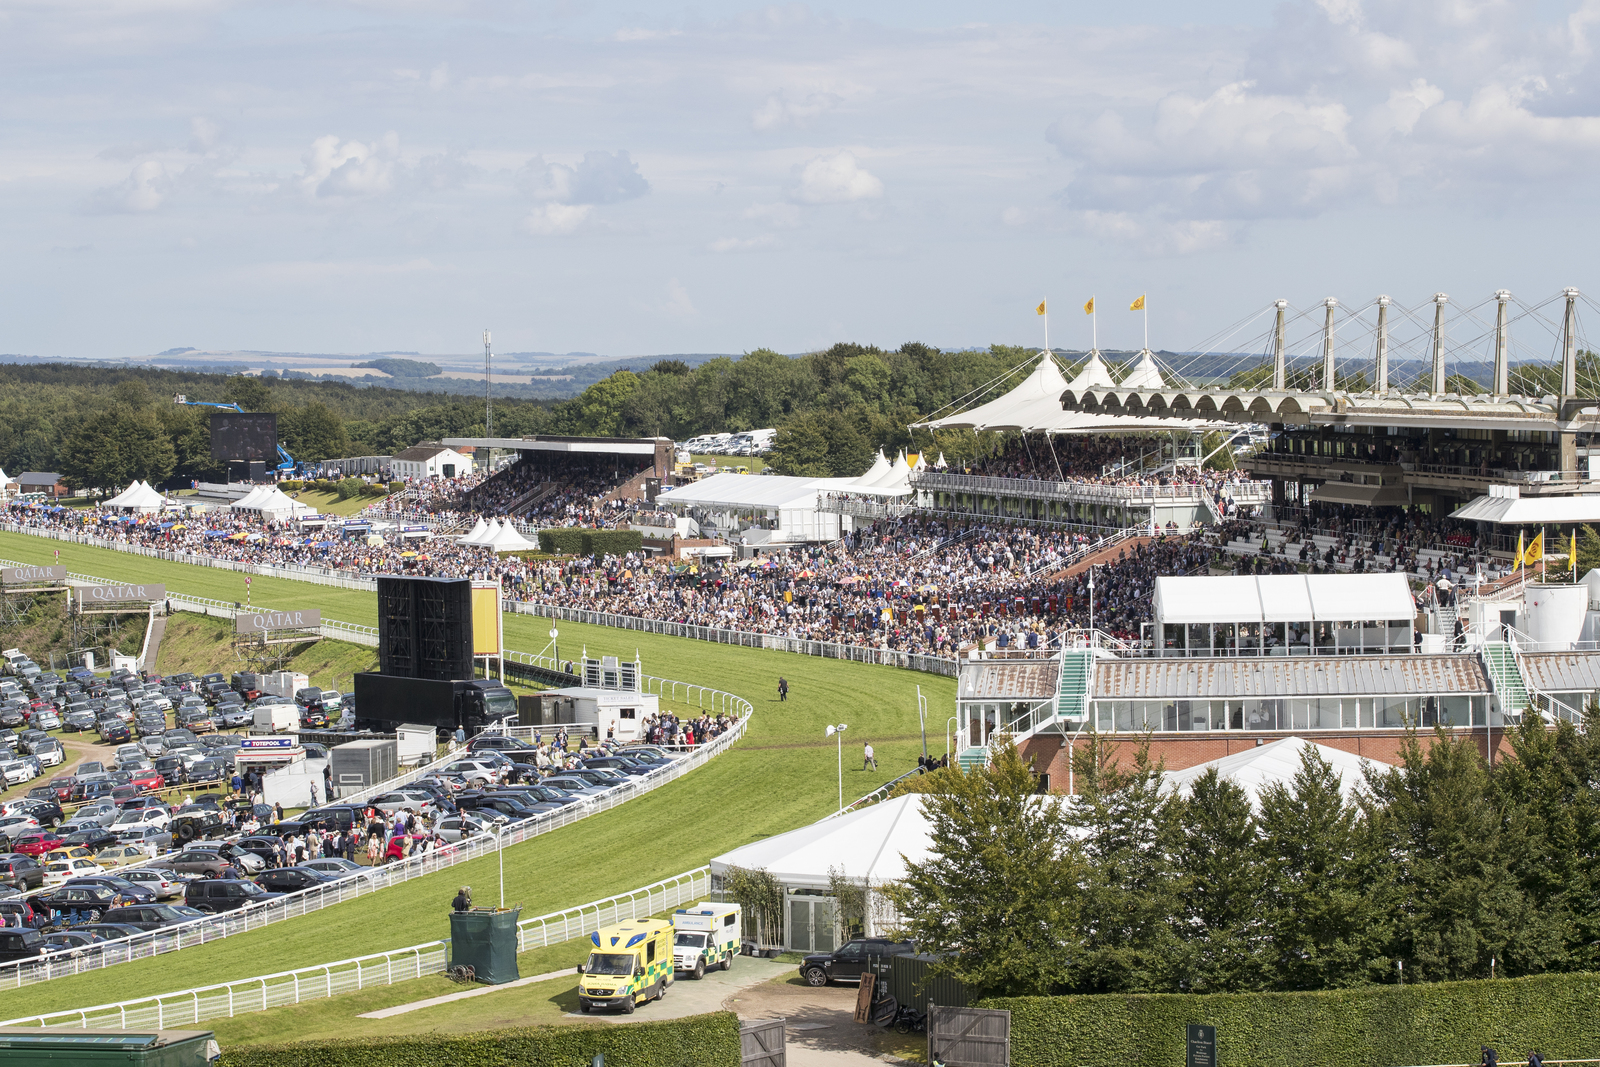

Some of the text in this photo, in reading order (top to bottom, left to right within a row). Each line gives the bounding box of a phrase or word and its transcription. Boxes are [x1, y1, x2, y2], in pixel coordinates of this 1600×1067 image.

[15, 567, 54, 581] QATAR
[92, 586, 146, 600] QATAR
[254, 612, 304, 630] QATAR
